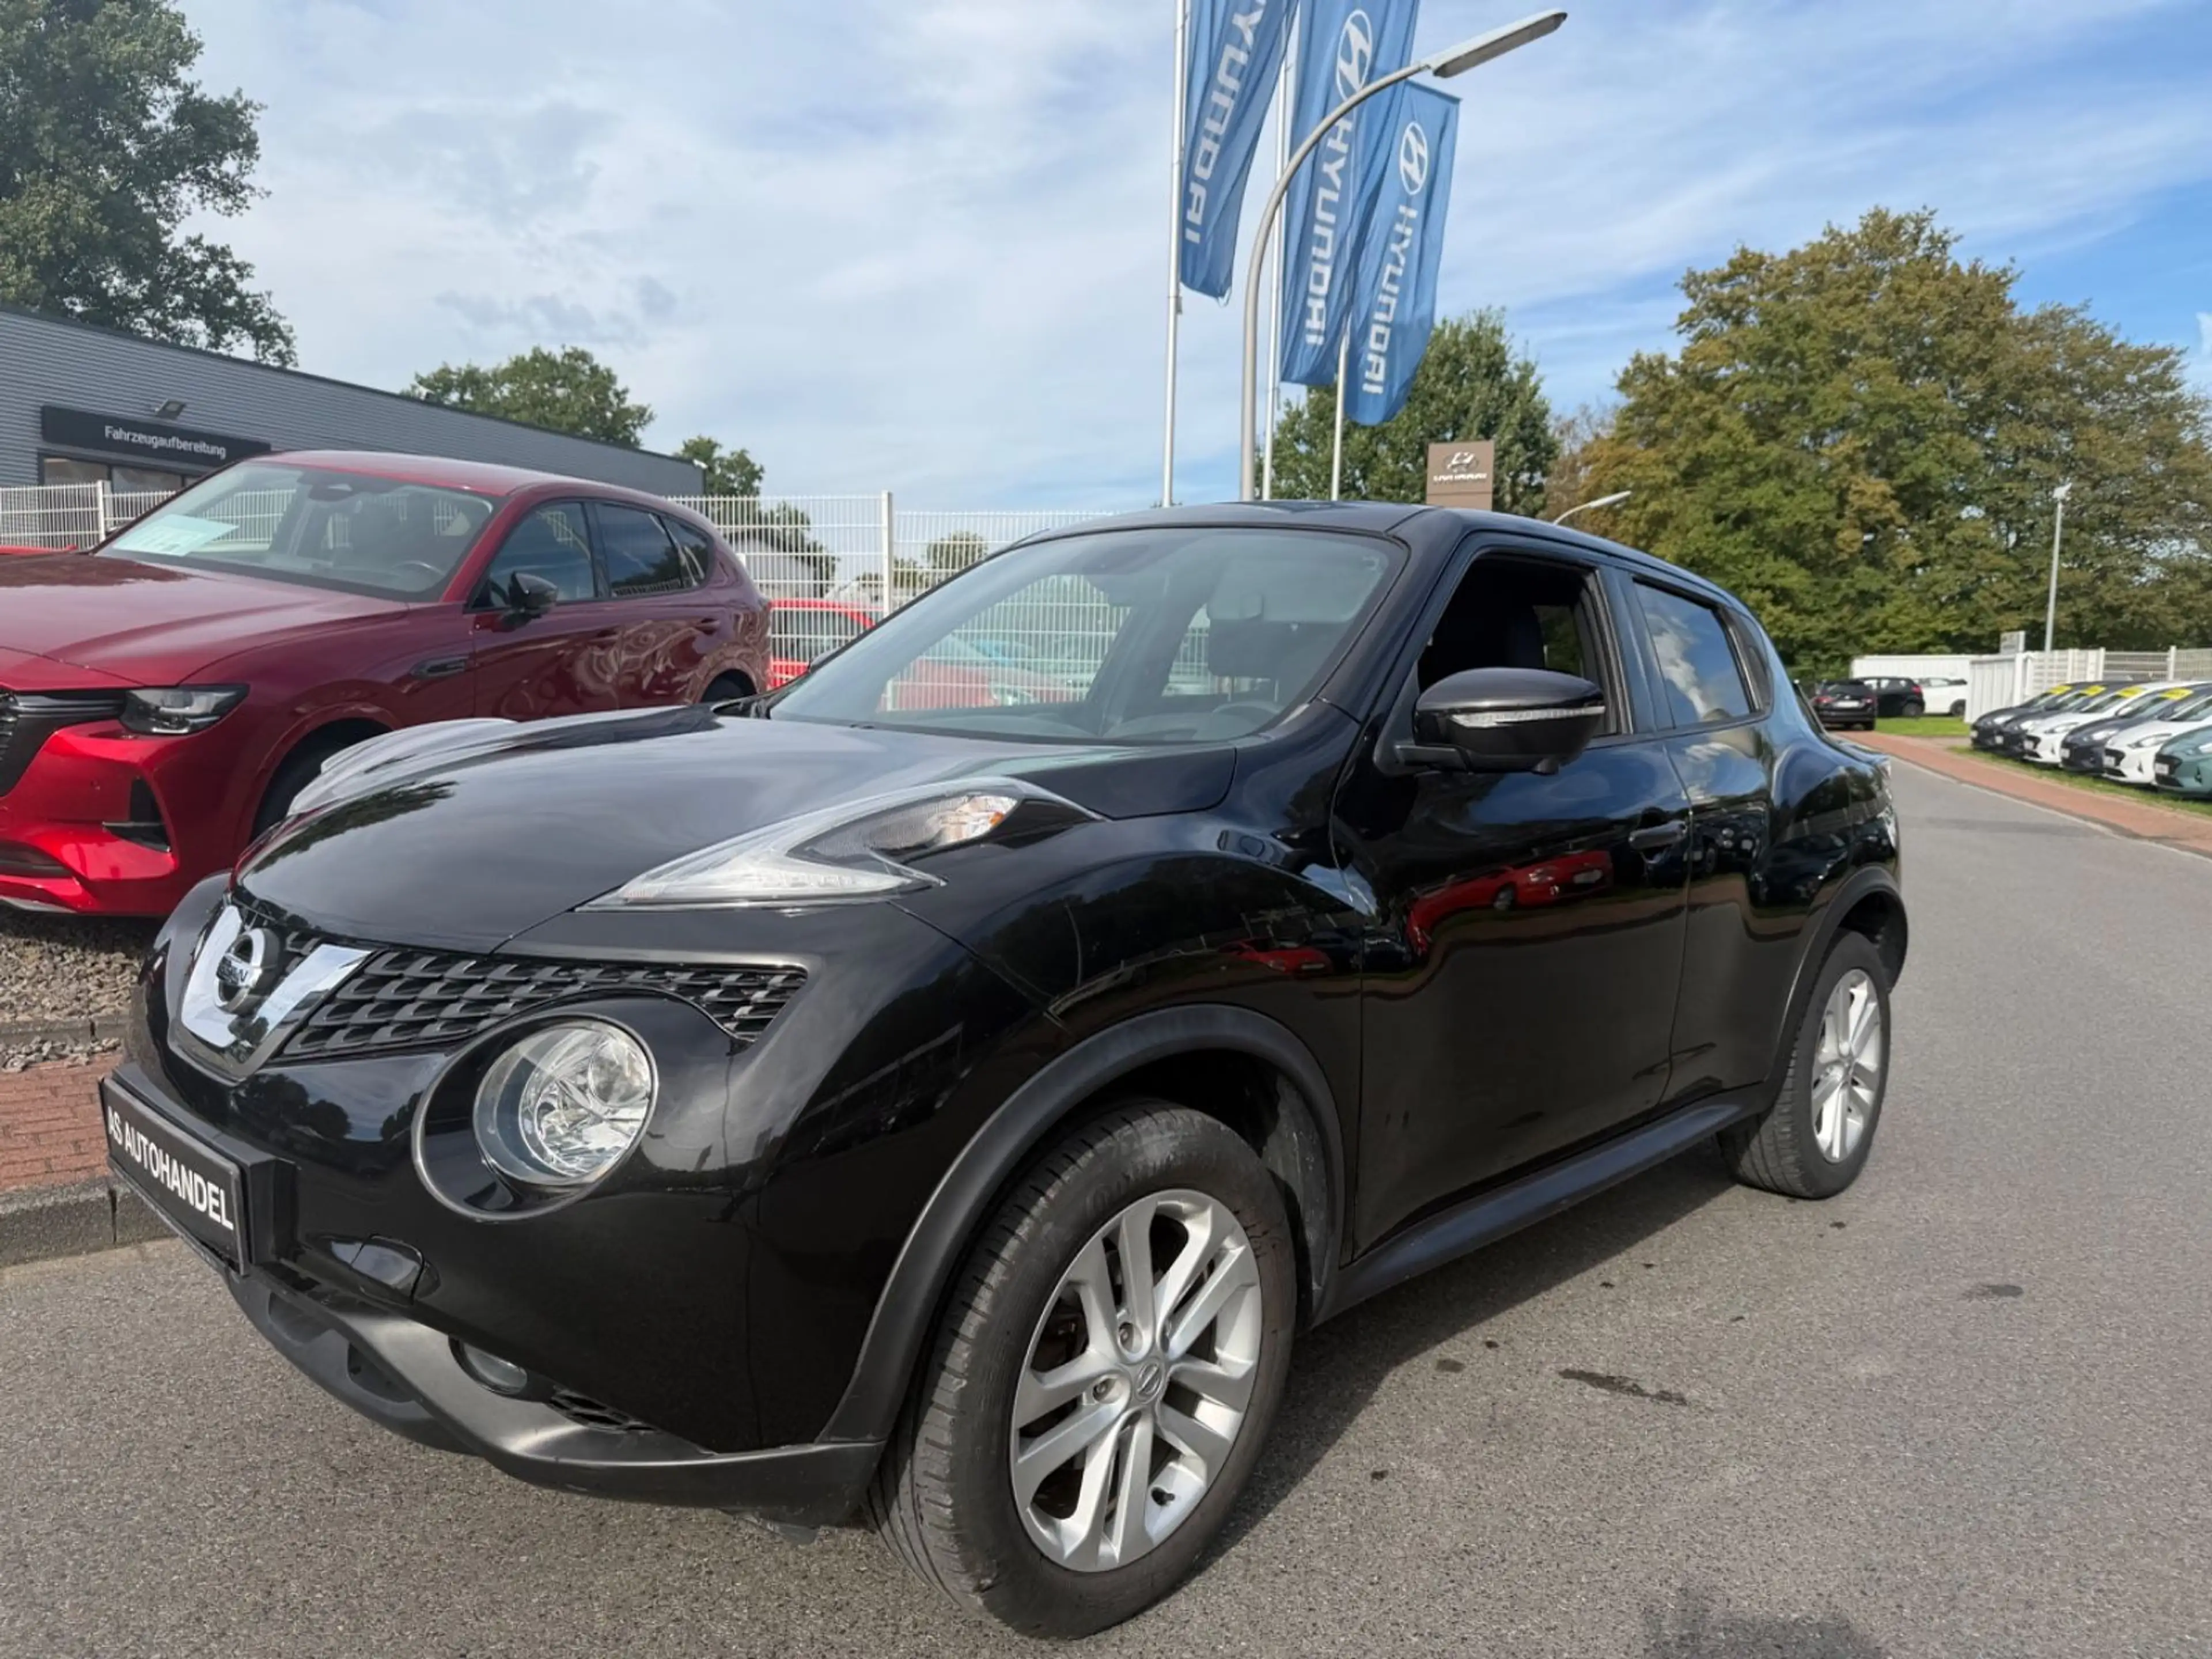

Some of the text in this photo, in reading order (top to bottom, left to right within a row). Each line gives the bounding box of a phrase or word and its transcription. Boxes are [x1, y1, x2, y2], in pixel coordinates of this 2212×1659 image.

[1185, 0, 1266, 244] YUNDAI
[1305, 117, 1353, 346] HYUNDAI
[1362, 204, 1418, 395] HYUNDAI
[104, 425, 226, 460] Fahrzeugaufbereitung
[108, 1105, 234, 1230] AS AUTOHANDEL
